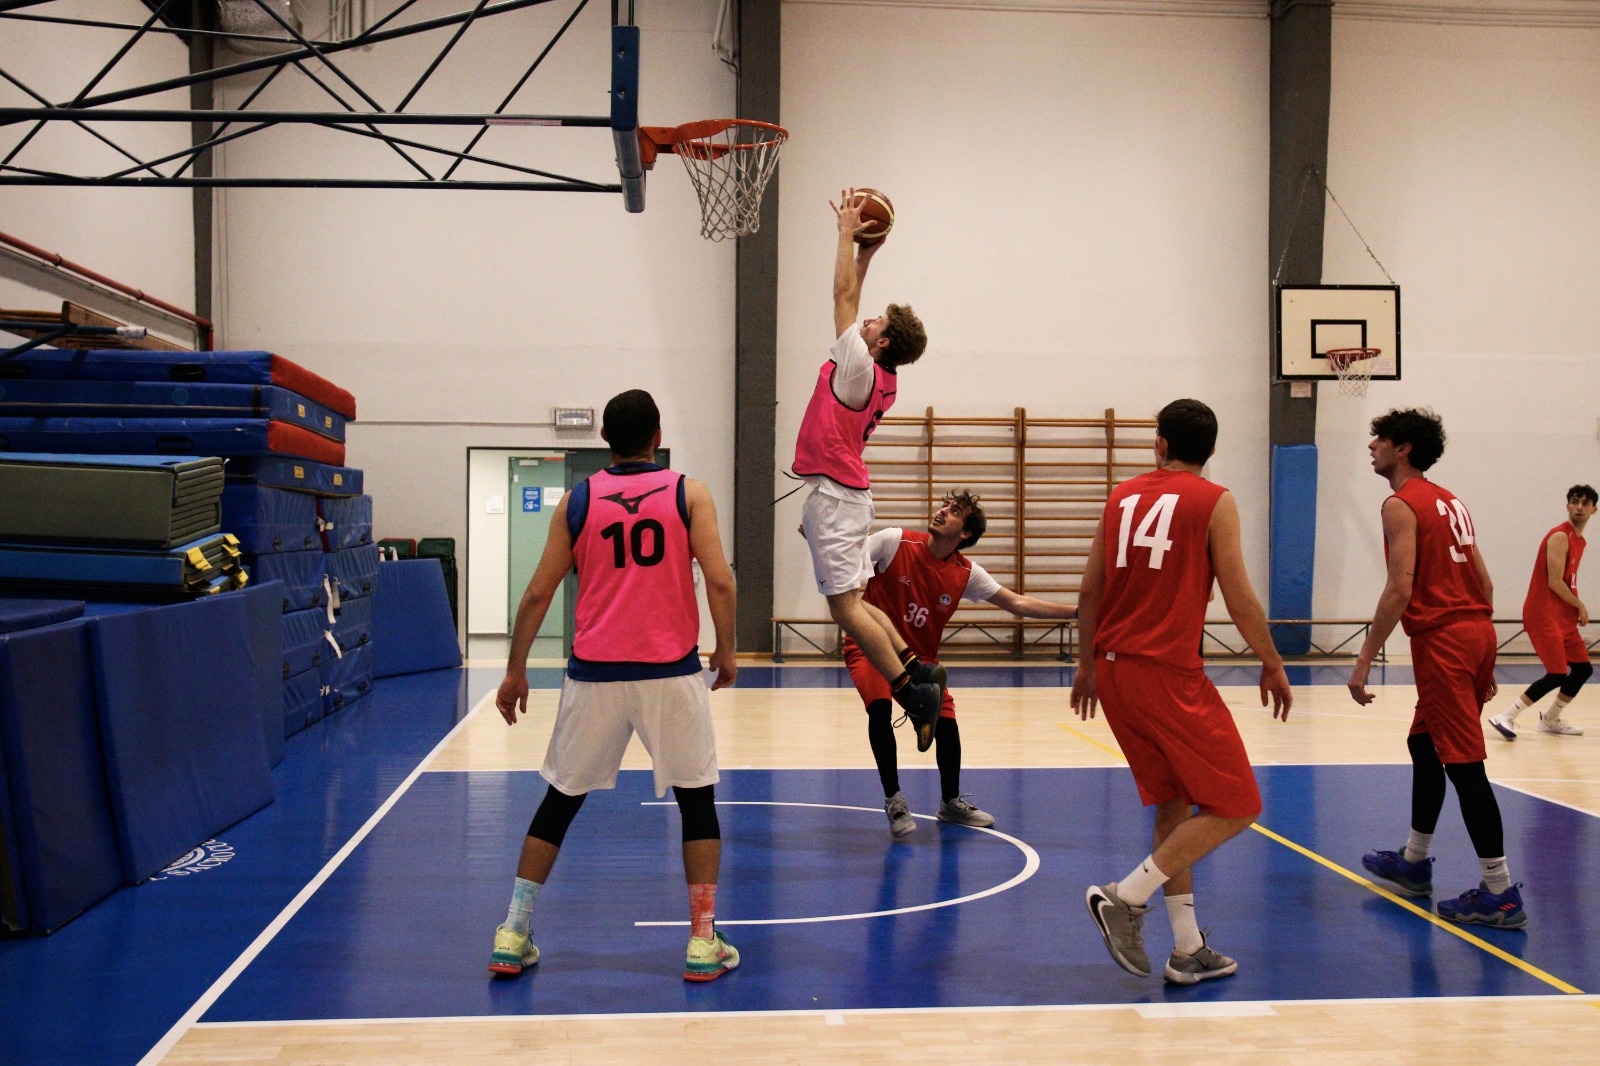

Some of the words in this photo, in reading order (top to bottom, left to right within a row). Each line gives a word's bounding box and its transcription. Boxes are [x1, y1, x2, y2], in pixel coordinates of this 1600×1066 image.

[600, 518, 665, 568] 10
[1116, 493, 1180, 570] 14
[1436, 498, 1475, 563] 34
[903, 602, 929, 628] 36
